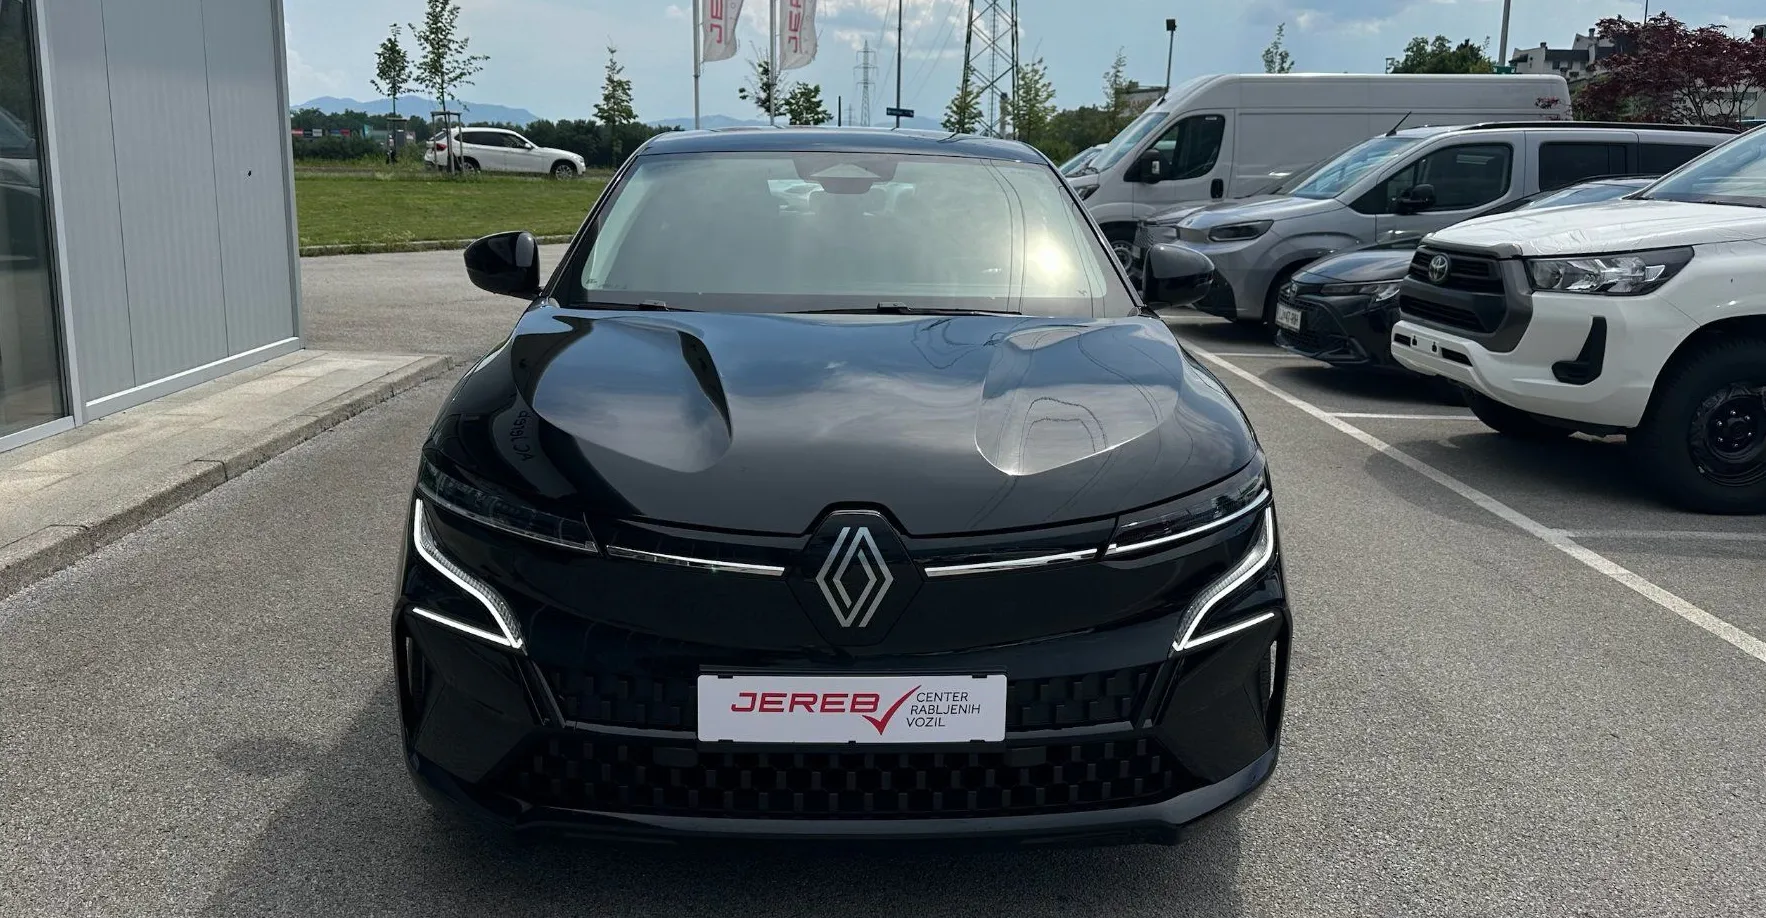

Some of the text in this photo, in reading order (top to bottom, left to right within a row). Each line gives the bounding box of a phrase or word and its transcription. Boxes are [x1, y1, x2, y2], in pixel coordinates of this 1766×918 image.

[731, 692, 880, 713] JEREB
[916, 691, 969, 703] CENTER
[910, 704, 981, 715] RABLJENIH
[906, 717, 946, 728] VOZIL
